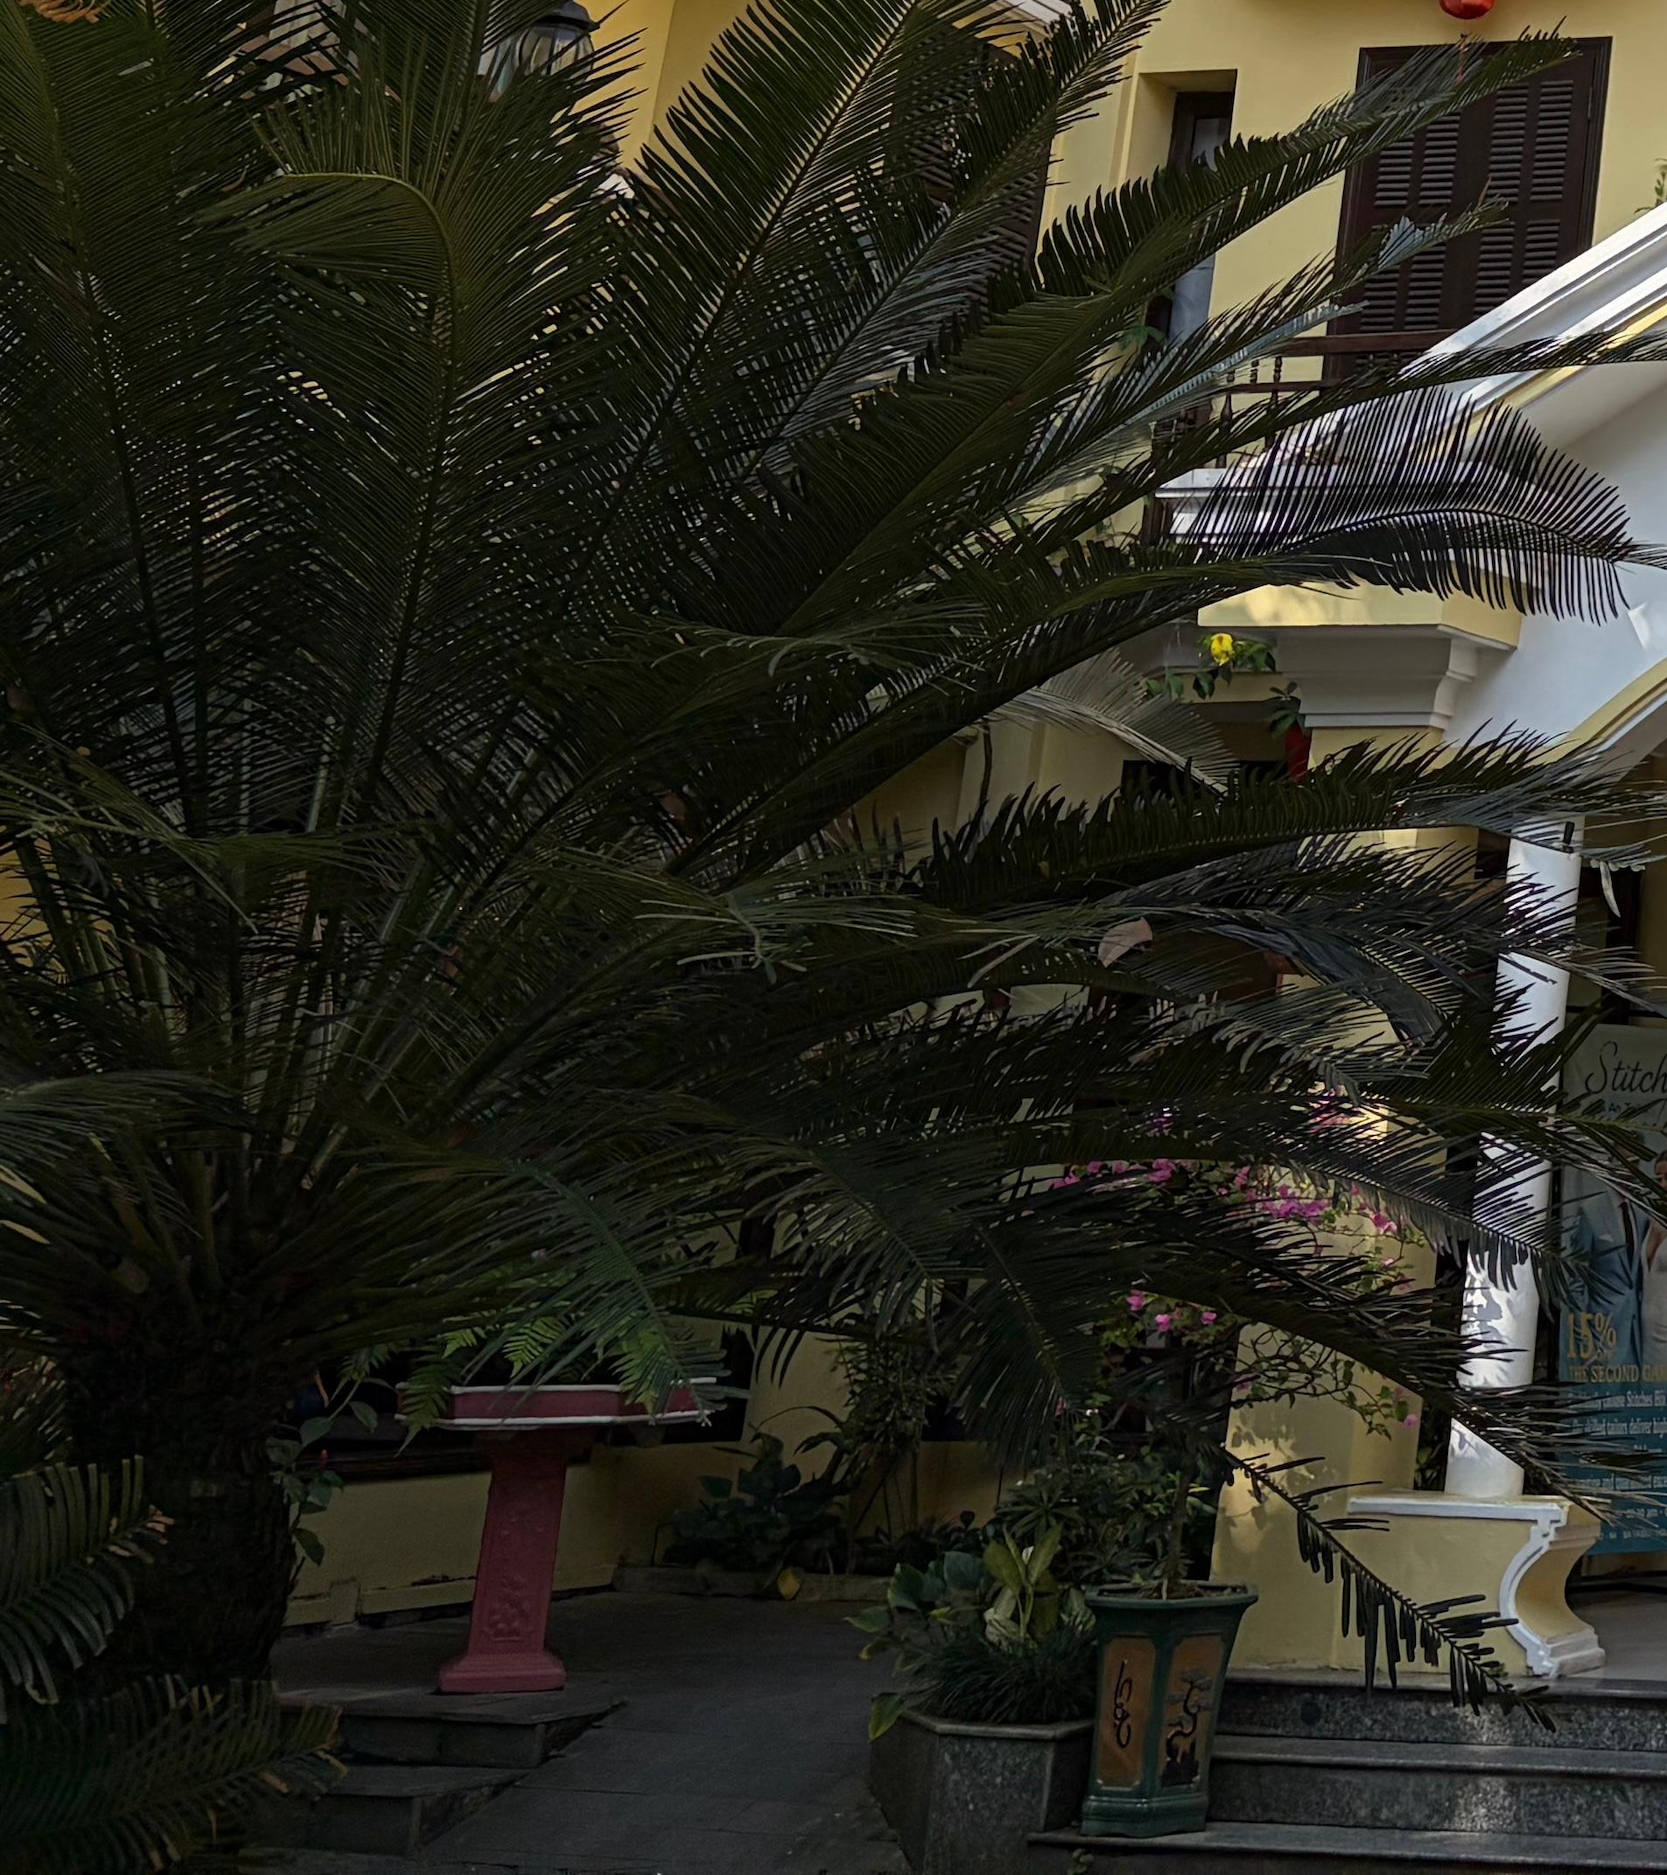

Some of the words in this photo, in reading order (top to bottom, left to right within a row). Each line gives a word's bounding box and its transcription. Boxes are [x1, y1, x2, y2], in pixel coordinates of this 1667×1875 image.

[1567, 1312, 1619, 1361] 15%
[1568, 1366, 1590, 1382] THE
[1591, 1364, 1641, 1382] SECOND
